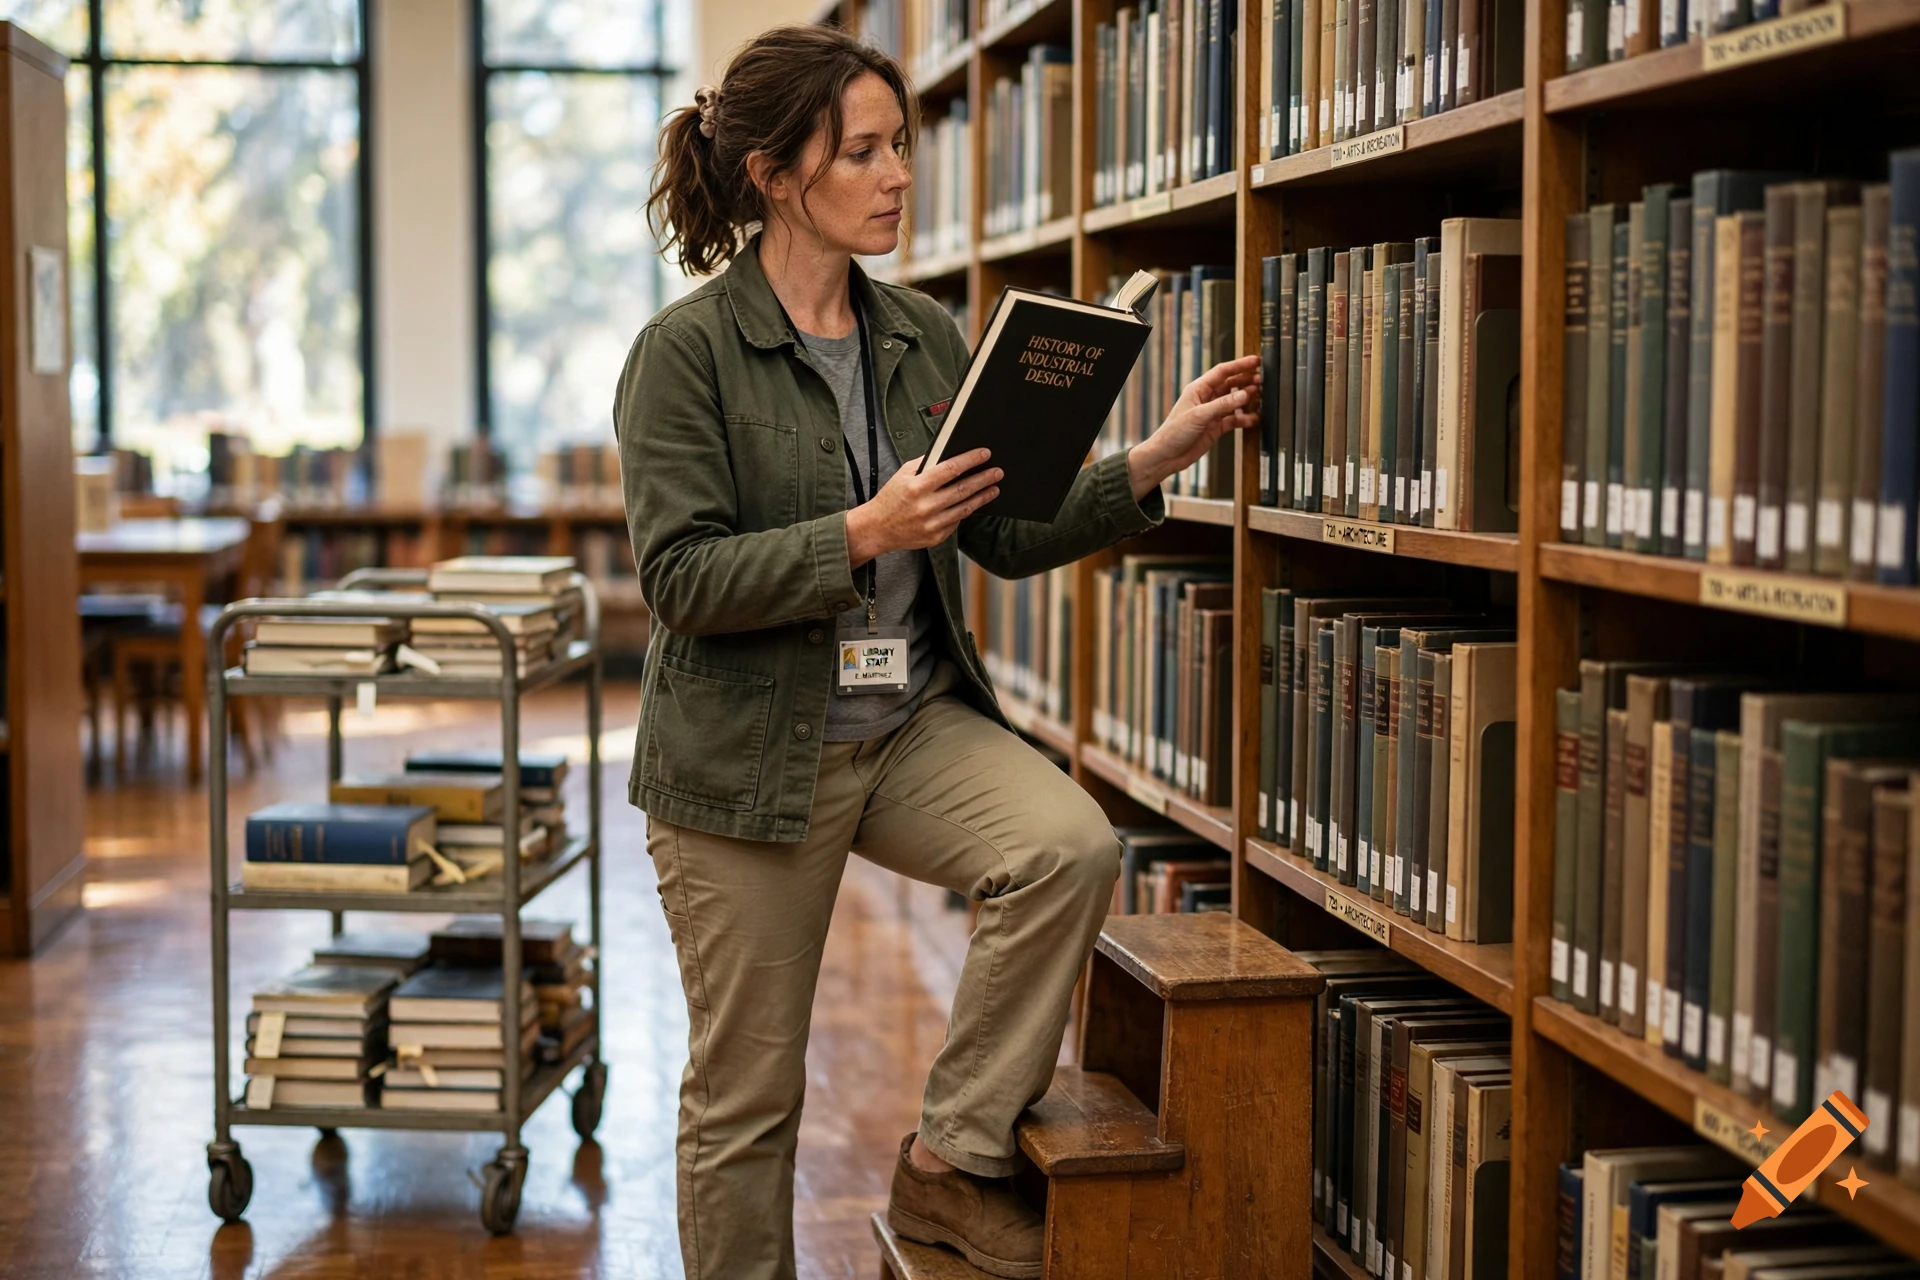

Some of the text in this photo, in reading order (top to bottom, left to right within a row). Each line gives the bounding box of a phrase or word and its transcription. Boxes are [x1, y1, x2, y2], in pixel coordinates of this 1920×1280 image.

[1332, 149, 1342, 162] 700
[1346, 143, 1361, 159] ARTS
[1367, 131, 1400, 153] RECREATION
[1027, 335, 1105, 360] HISTORY OF
[1019, 350, 1094, 376] INDUSTRIAL
[1025, 368, 1075, 389] DESIGN
[862, 647, 895, 657] LIBRARY
[865, 657, 889, 667] STAFF
[1344, 904, 1386, 939] ARCHITECTURE
